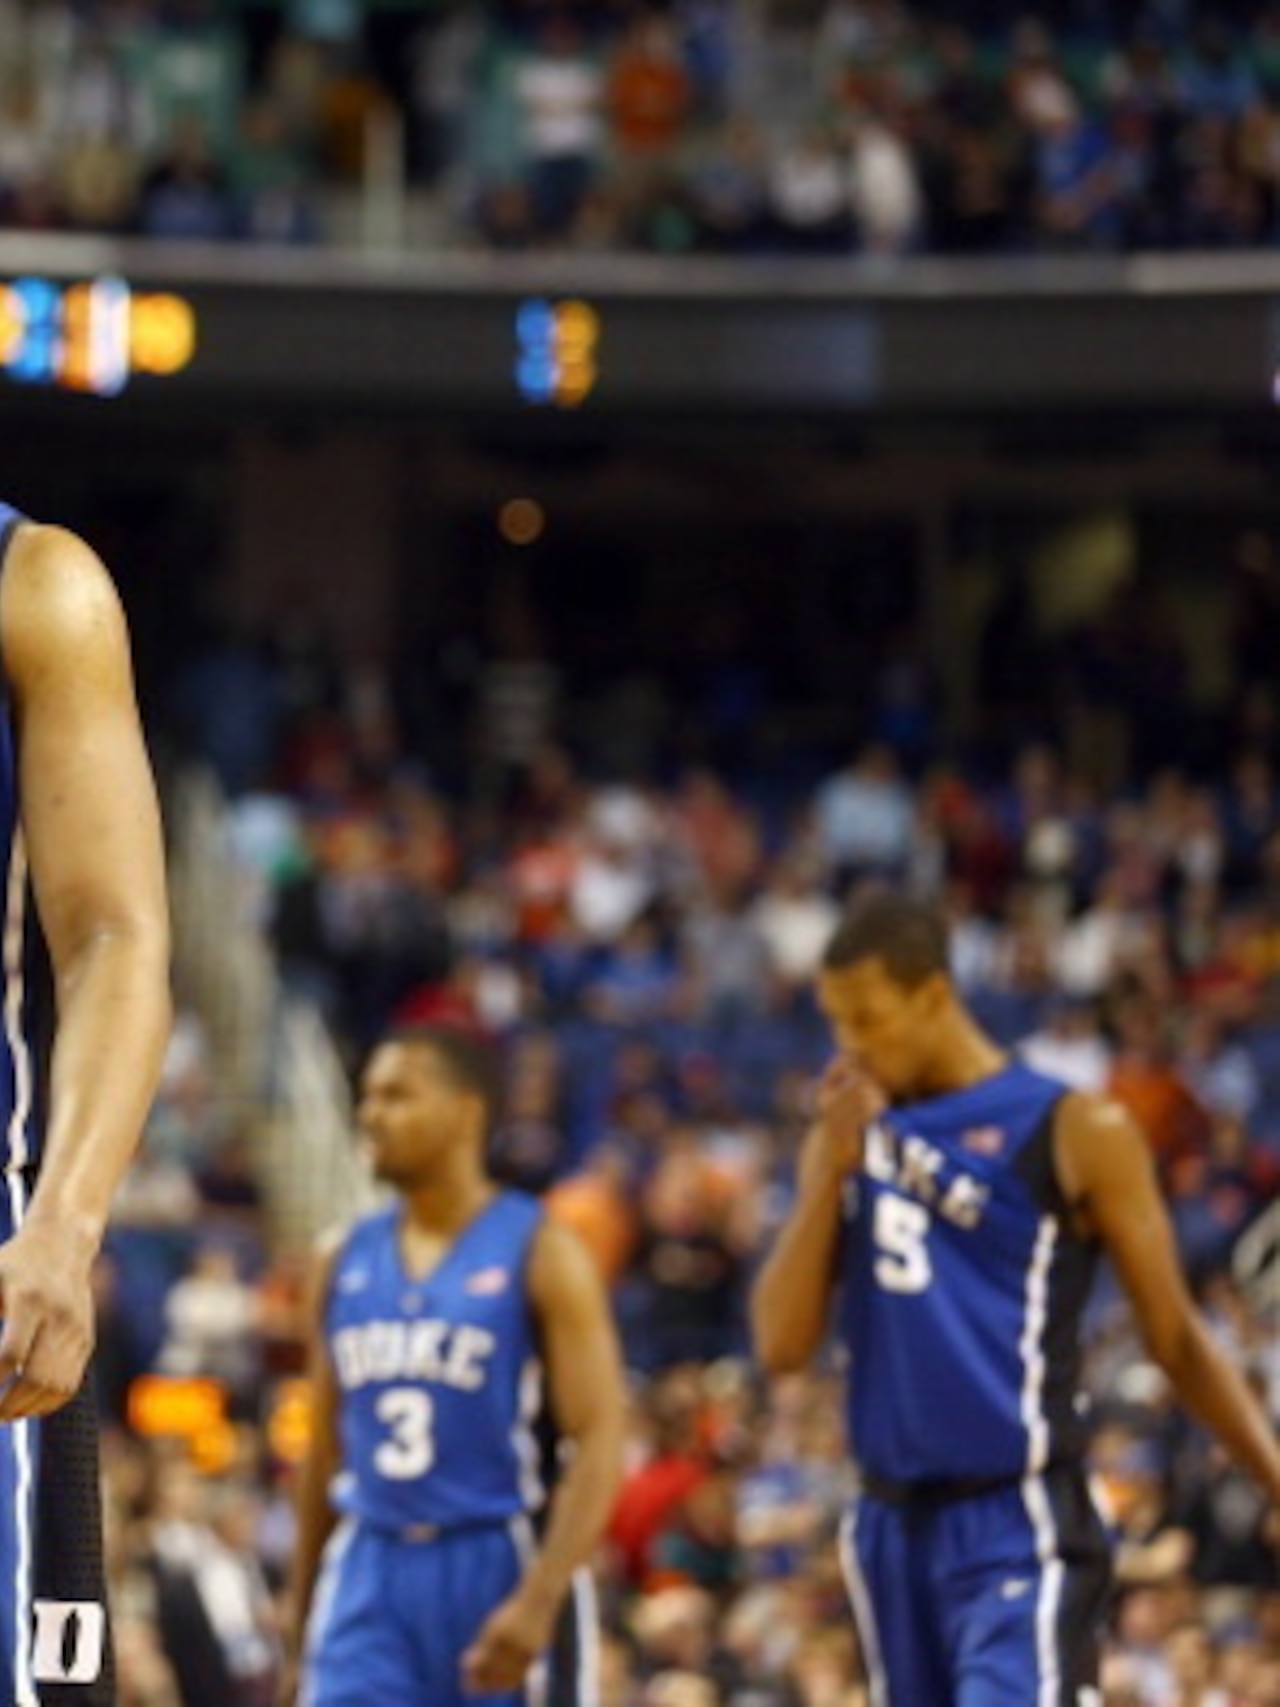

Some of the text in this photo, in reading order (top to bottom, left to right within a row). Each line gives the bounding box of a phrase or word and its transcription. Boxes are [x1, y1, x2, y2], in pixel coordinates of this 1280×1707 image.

[864, 1122, 991, 1232] UKE
[873, 1191, 932, 1294] 5
[332, 1319, 495, 1391] DUKE
[373, 1387, 435, 1480] 3
